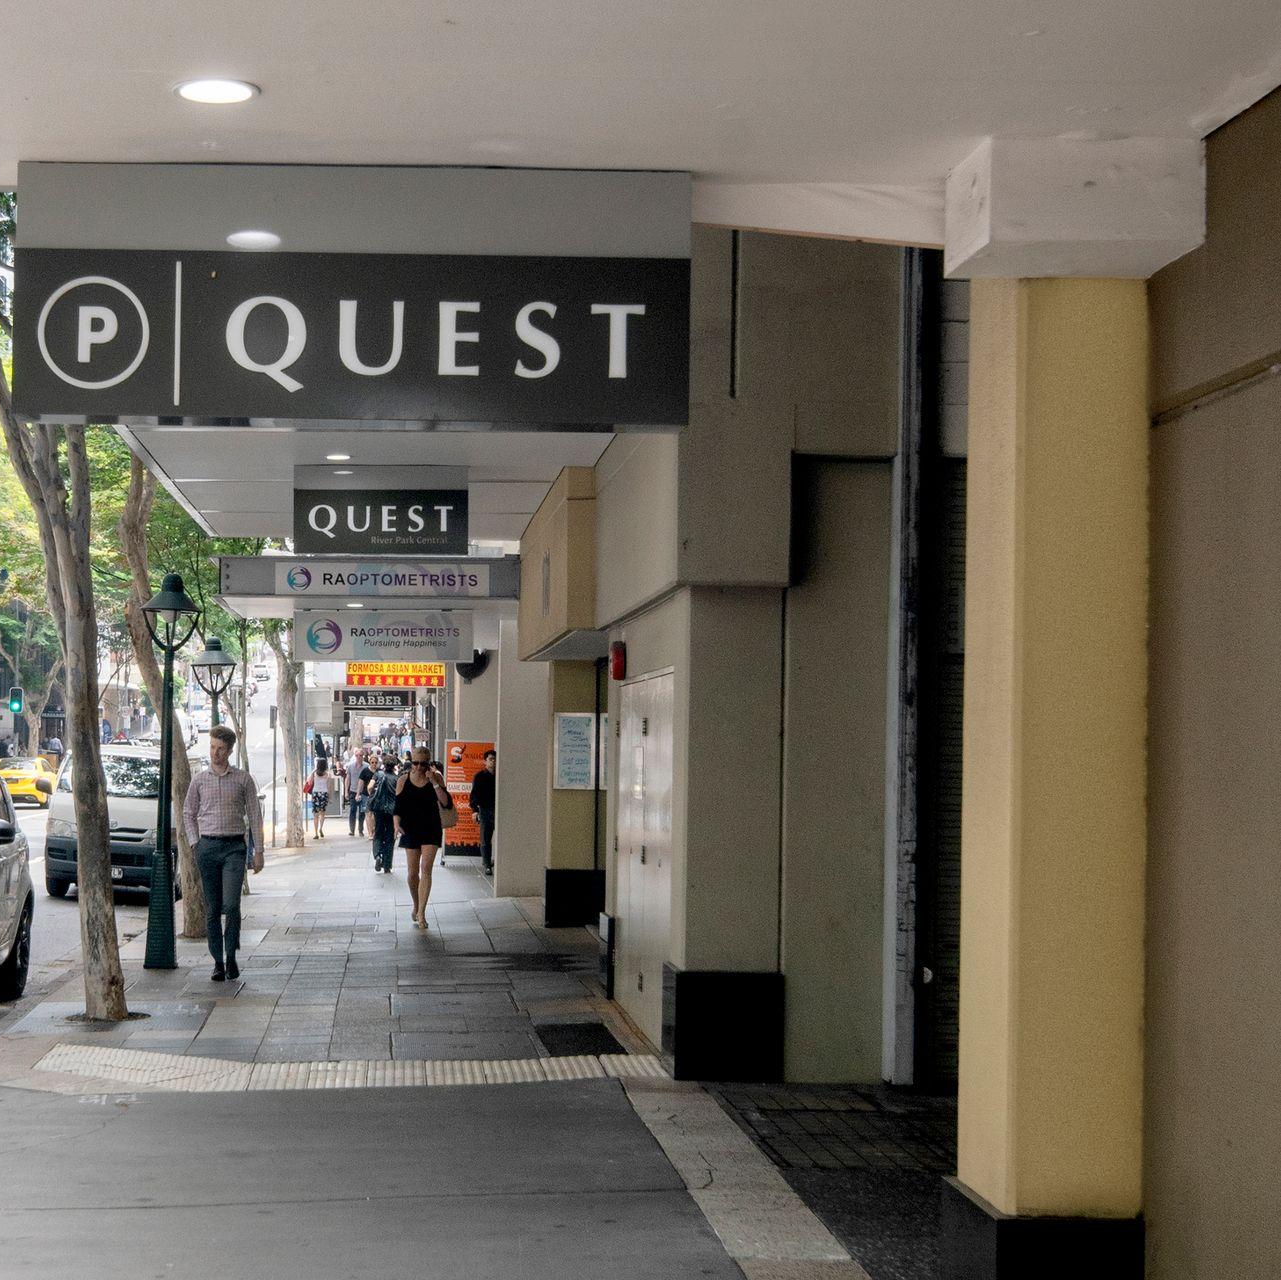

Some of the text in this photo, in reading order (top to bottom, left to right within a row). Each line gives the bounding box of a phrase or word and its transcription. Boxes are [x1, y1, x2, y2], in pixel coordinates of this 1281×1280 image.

[76, 294, 647, 394] P QUEST
[307, 503, 454, 539] QUEST
[370, 535, 448, 545] River Park Central
[322, 572, 479, 587] RAOPTOMETRISTS
[350, 627, 460, 638] RAOPTOMETRISTS
[363, 638, 448, 649] Pursuing Happiness
[347, 663, 444, 674] FORMOSA ASIAN MARKET
[348, 695, 402, 706] BARBER
